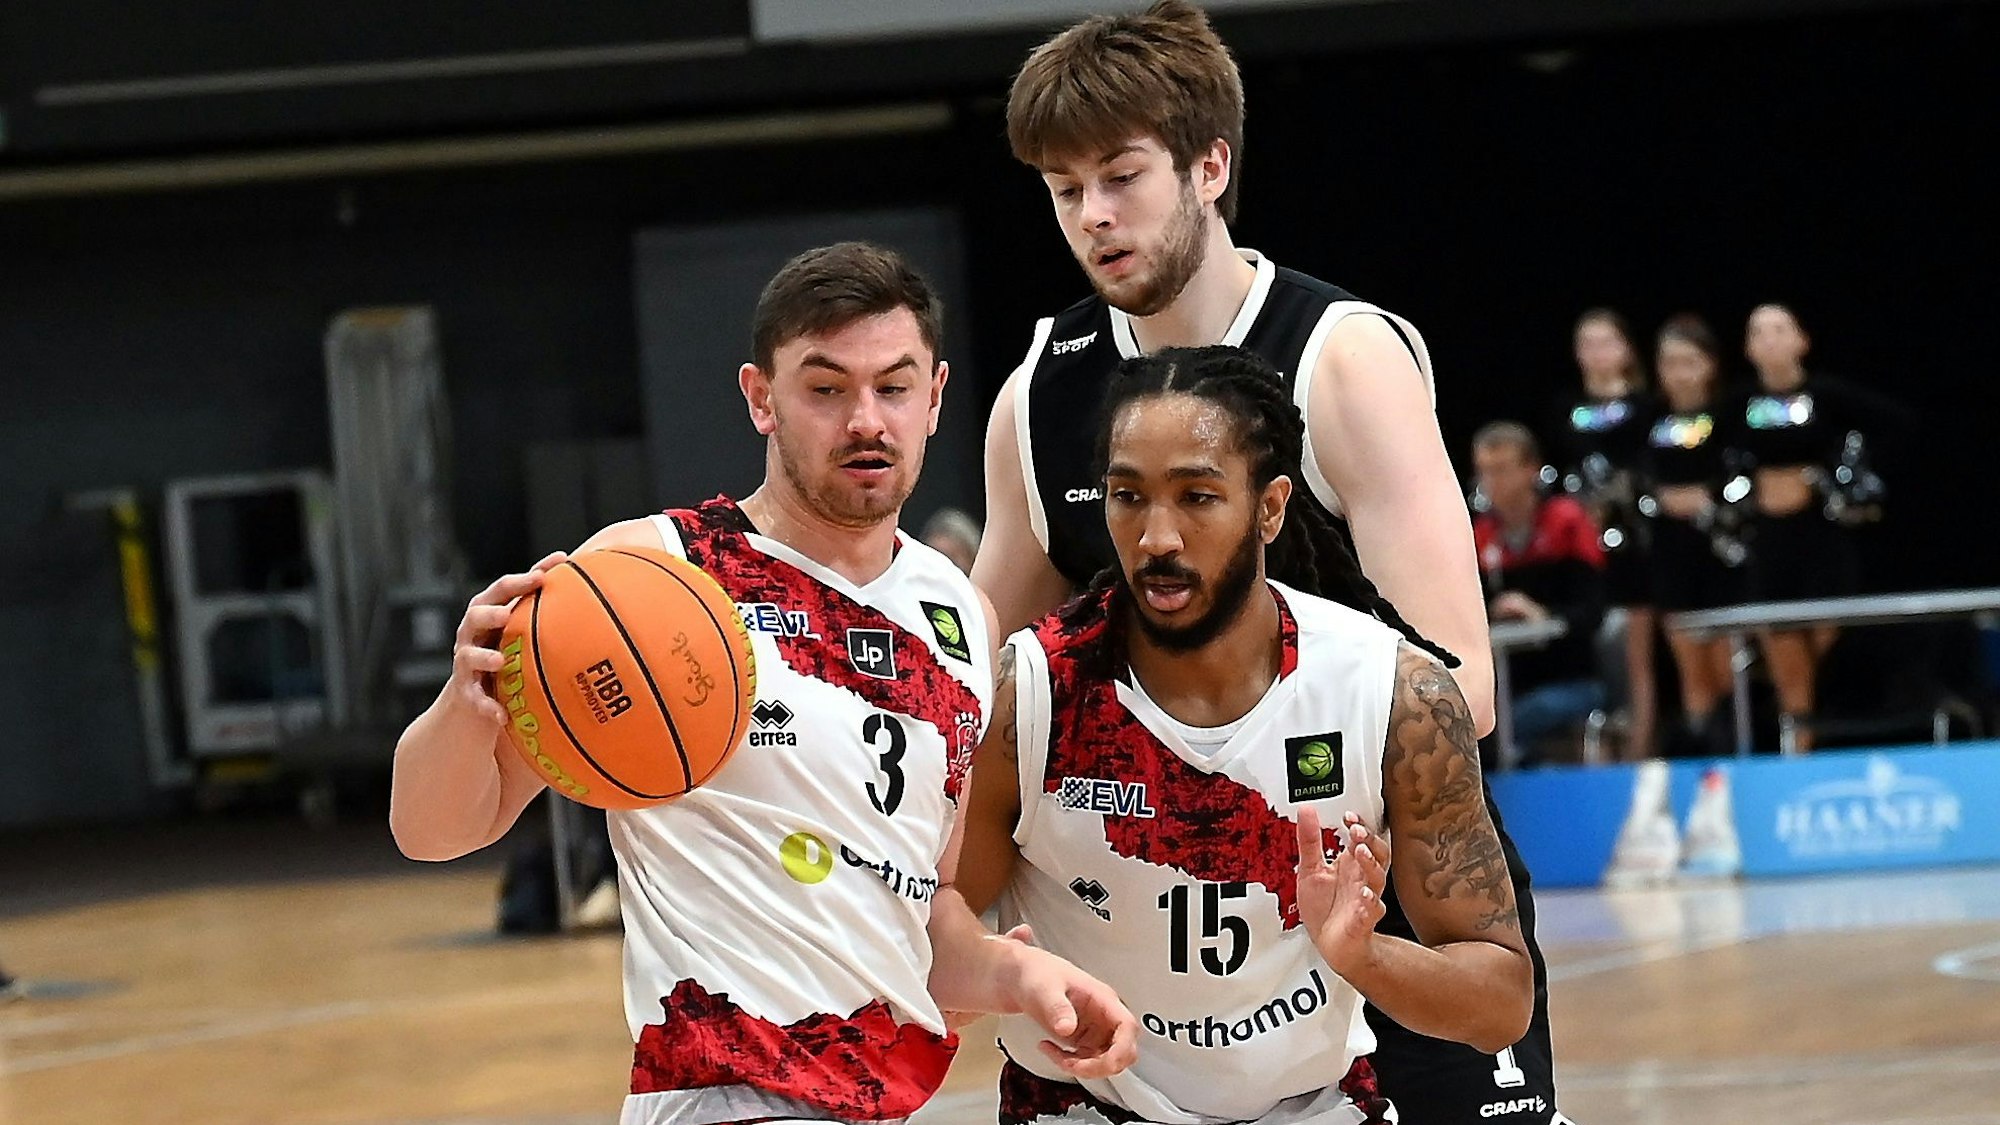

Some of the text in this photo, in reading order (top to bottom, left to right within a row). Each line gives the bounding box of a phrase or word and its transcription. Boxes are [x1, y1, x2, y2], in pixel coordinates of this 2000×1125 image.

[1065, 488, 1103, 502] CRA
[755, 604, 821, 640] EVL
[574, 671, 609, 725] APPROVED
[586, 658, 633, 718] FIBA
[749, 731, 797, 747] errea
[863, 713, 907, 817] 3
[1090, 782, 1155, 817] EVL
[1157, 881, 1251, 977] 15
[1142, 969, 1328, 1048] orthomol
[1480, 1098, 1535, 1118] CRAFT
